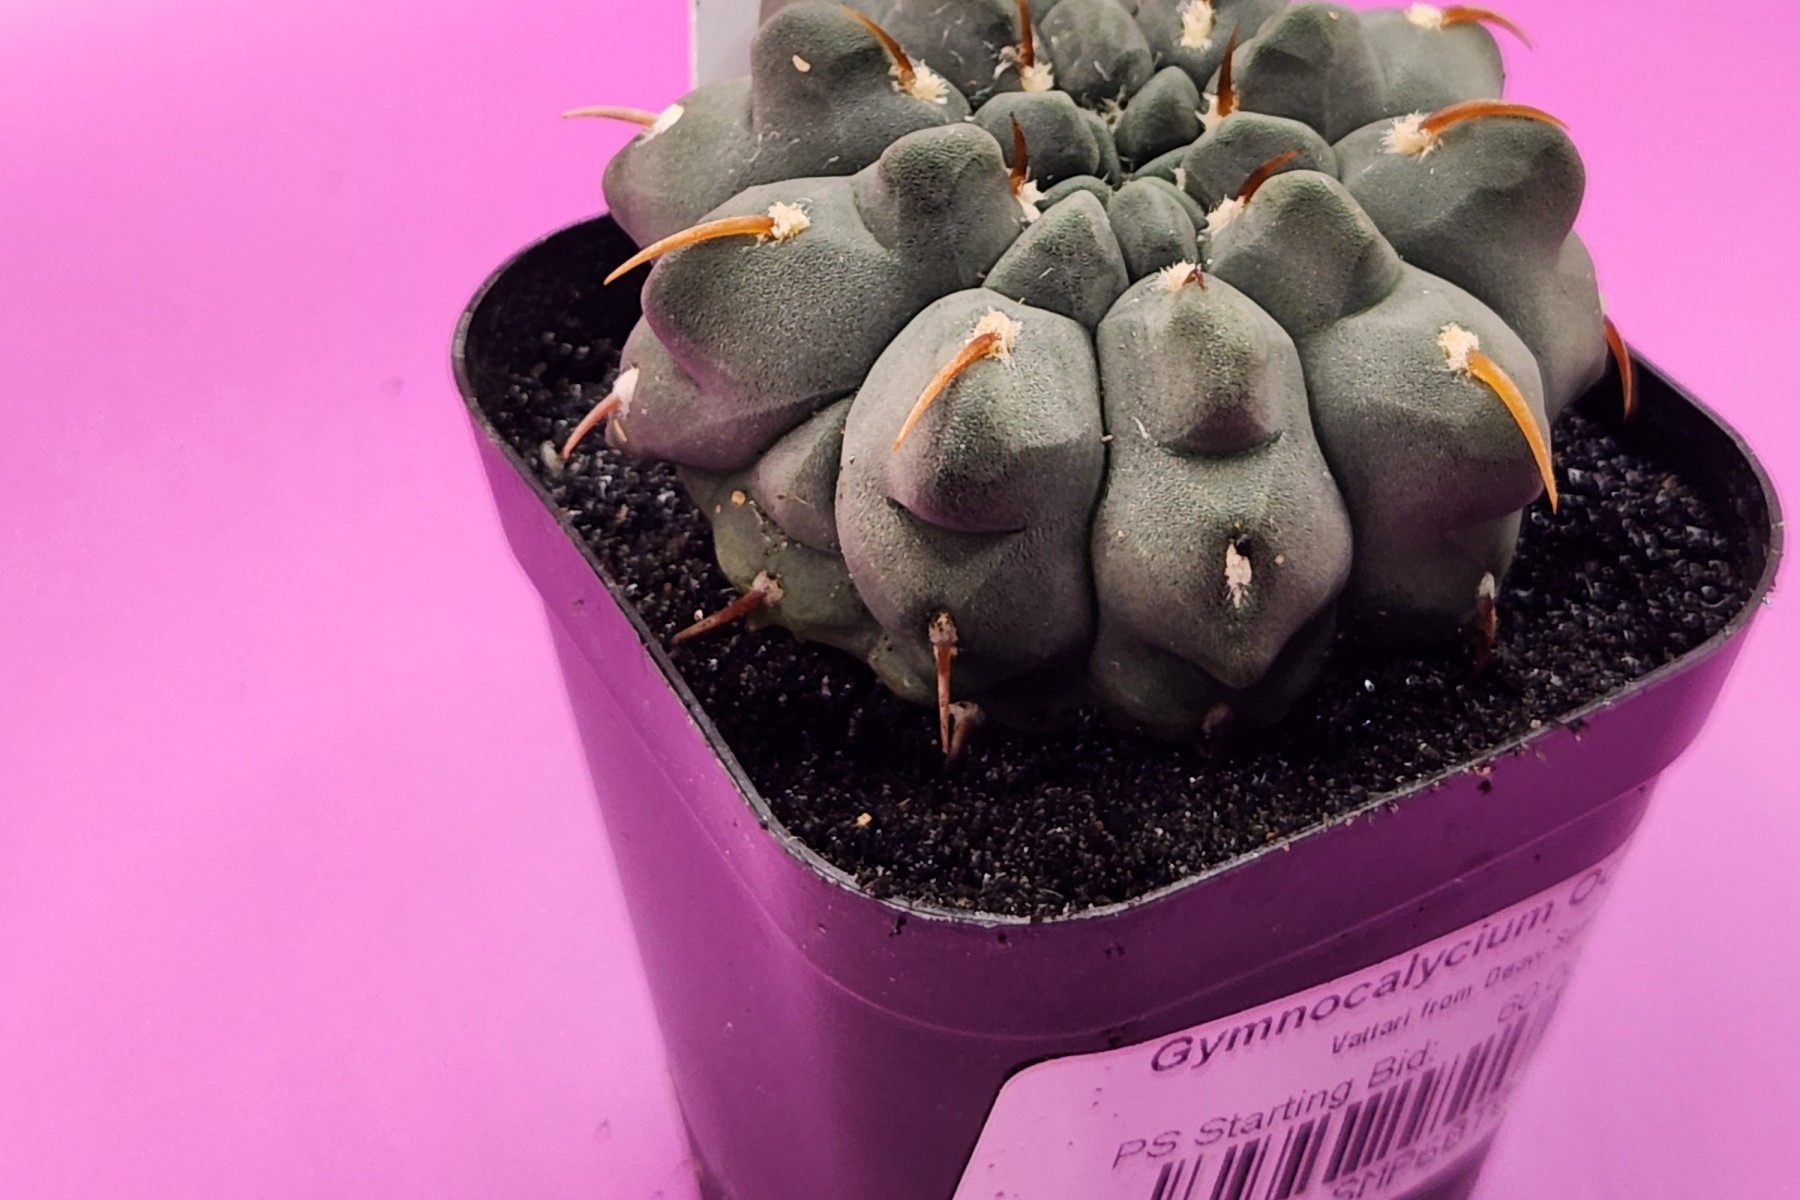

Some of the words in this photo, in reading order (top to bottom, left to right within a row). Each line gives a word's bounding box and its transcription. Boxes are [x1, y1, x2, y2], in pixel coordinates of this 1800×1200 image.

[1151, 899, 1555, 1073] Gymnocalycium
[1420, 984, 1474, 1020] from
[1112, 1130, 1182, 1170] PS
[1194, 1078, 1353, 1147] Starting
